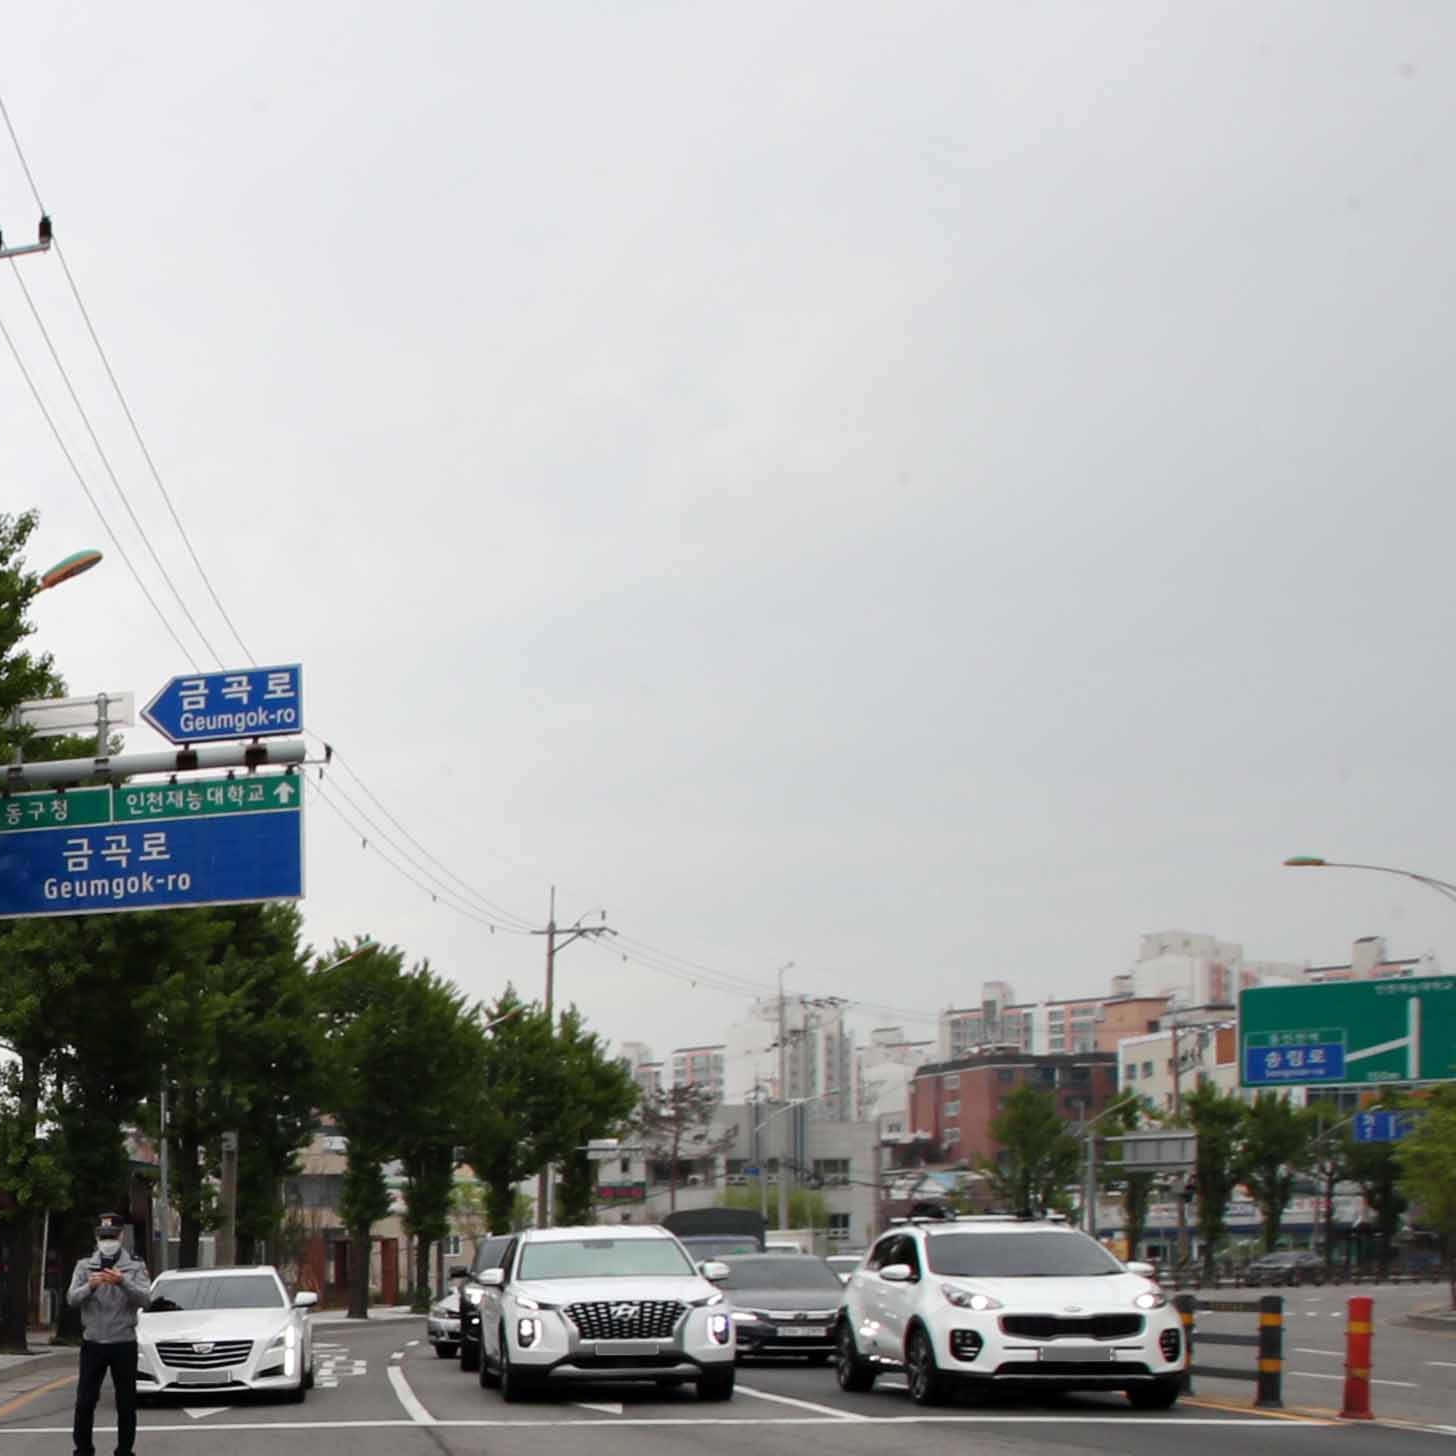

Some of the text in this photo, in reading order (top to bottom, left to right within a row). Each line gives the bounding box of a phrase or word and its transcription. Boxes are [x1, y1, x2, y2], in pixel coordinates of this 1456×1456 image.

[179, 673, 295, 710] 금곡로
[179, 704, 295, 734] Geumgok-ro
[5, 800, 67, 825] 동구청
[126, 783, 265, 814] 인천재능대학교
[63, 832, 170, 872] 금곡로
[44, 871, 191, 900] Geumgok-ro
